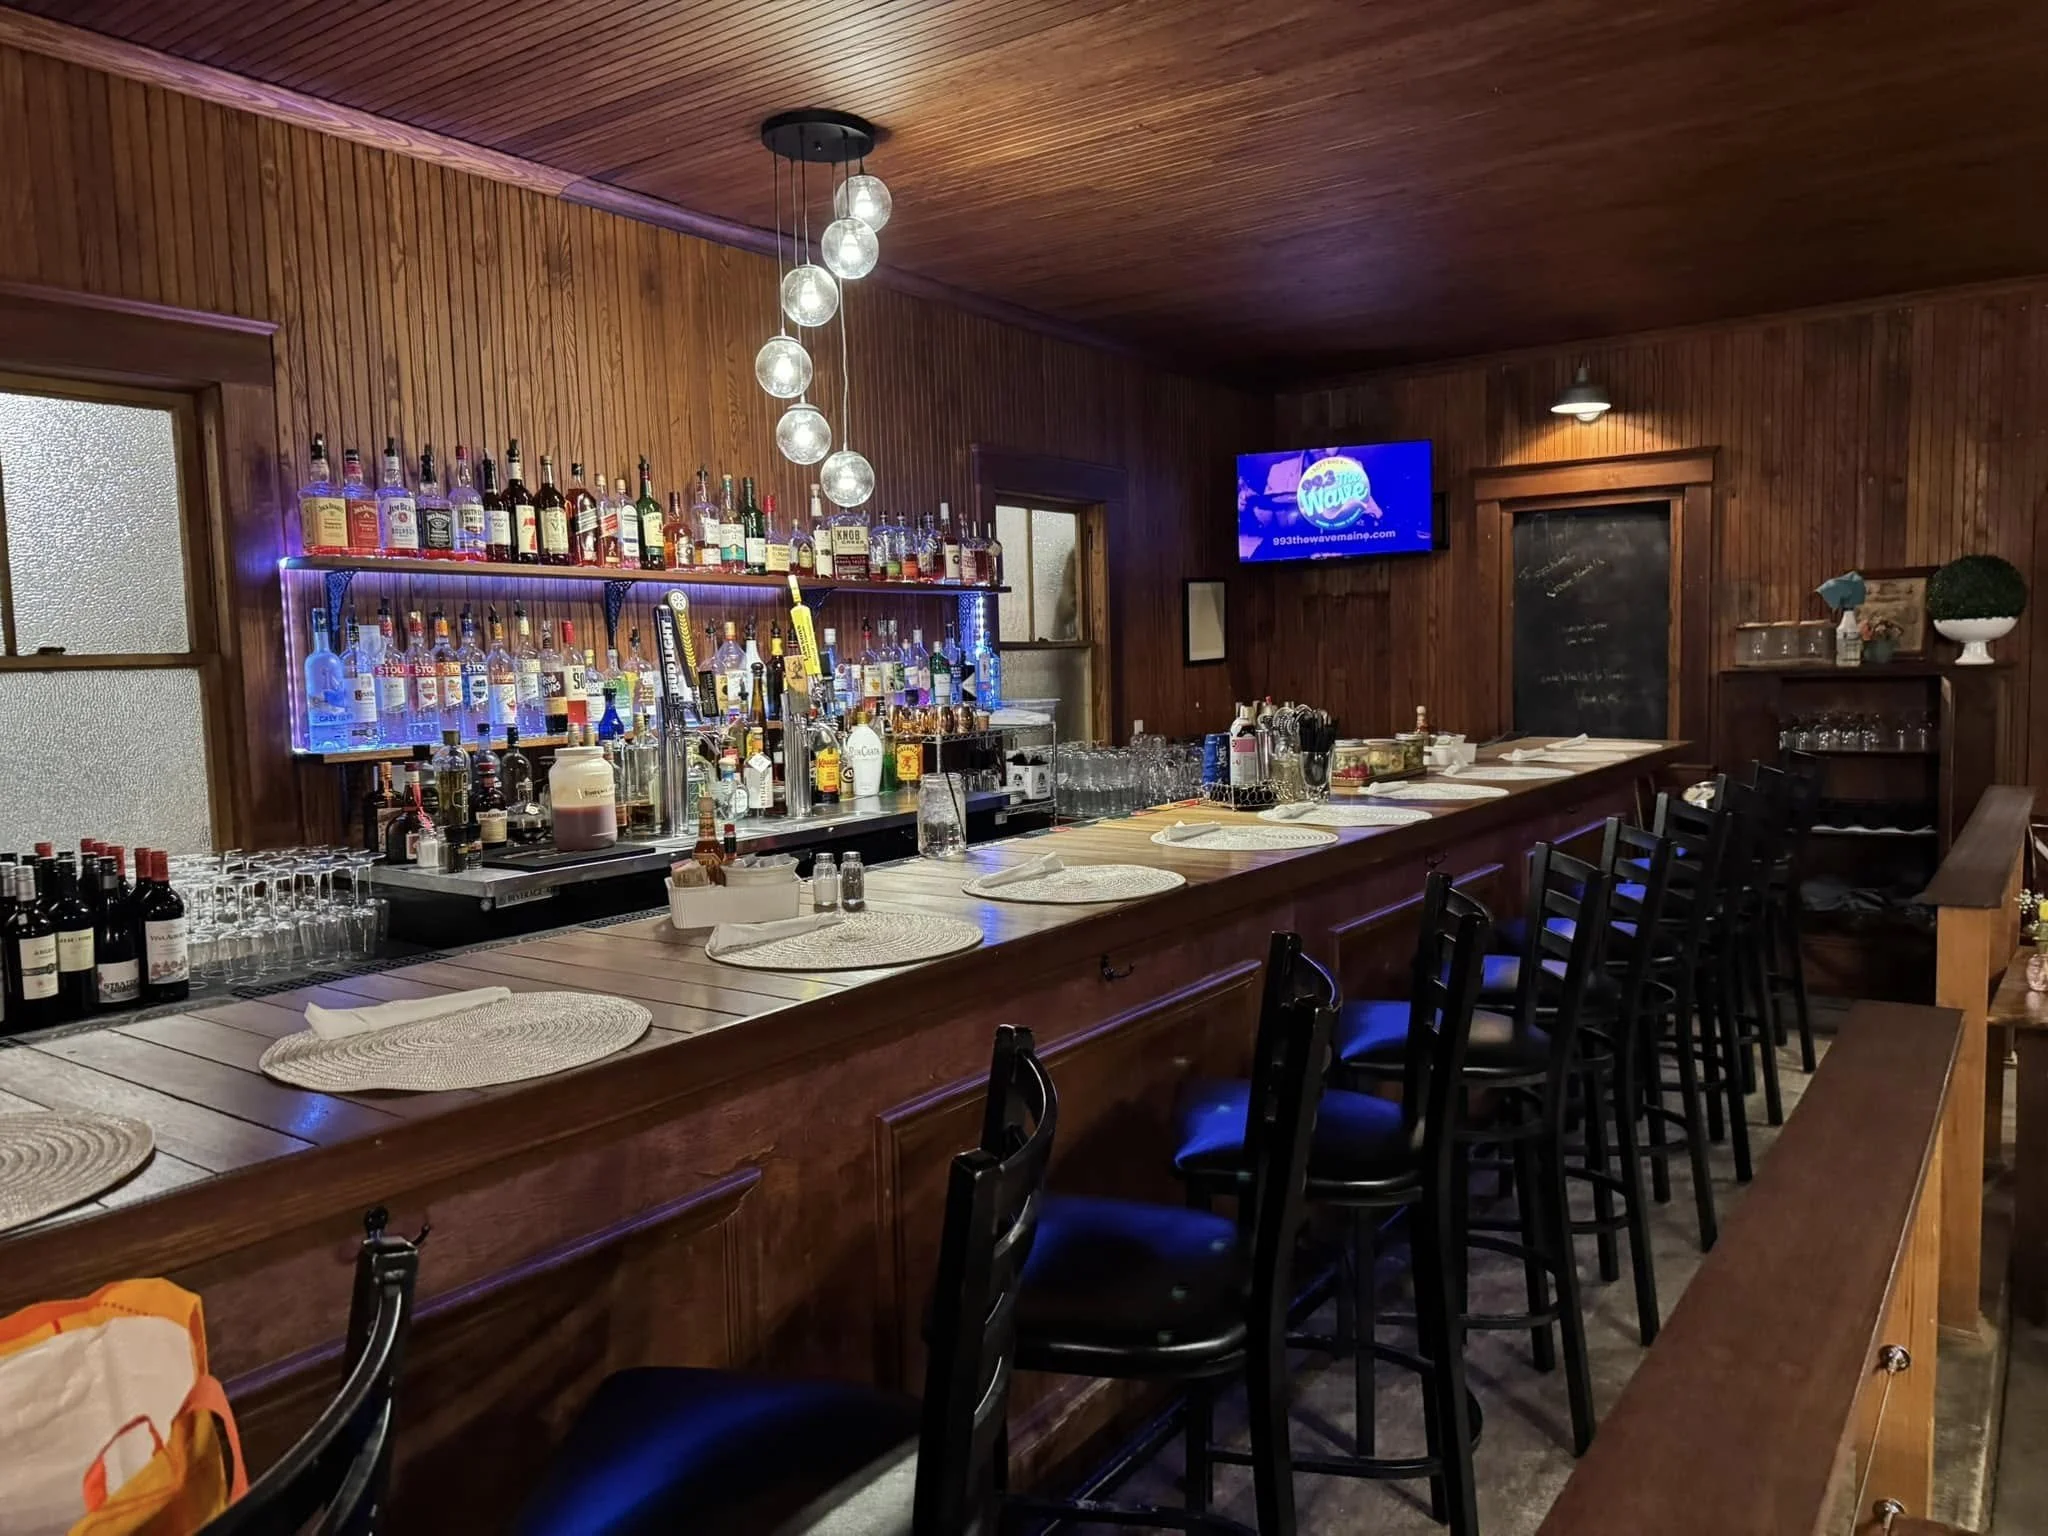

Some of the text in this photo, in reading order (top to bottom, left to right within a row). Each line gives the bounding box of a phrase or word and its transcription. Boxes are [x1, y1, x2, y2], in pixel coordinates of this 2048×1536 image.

[1300, 483, 1369, 517] Wave
[837, 529, 860, 540] KNOB
[1273, 530, 1397, 546] 993thewavemaine.com
